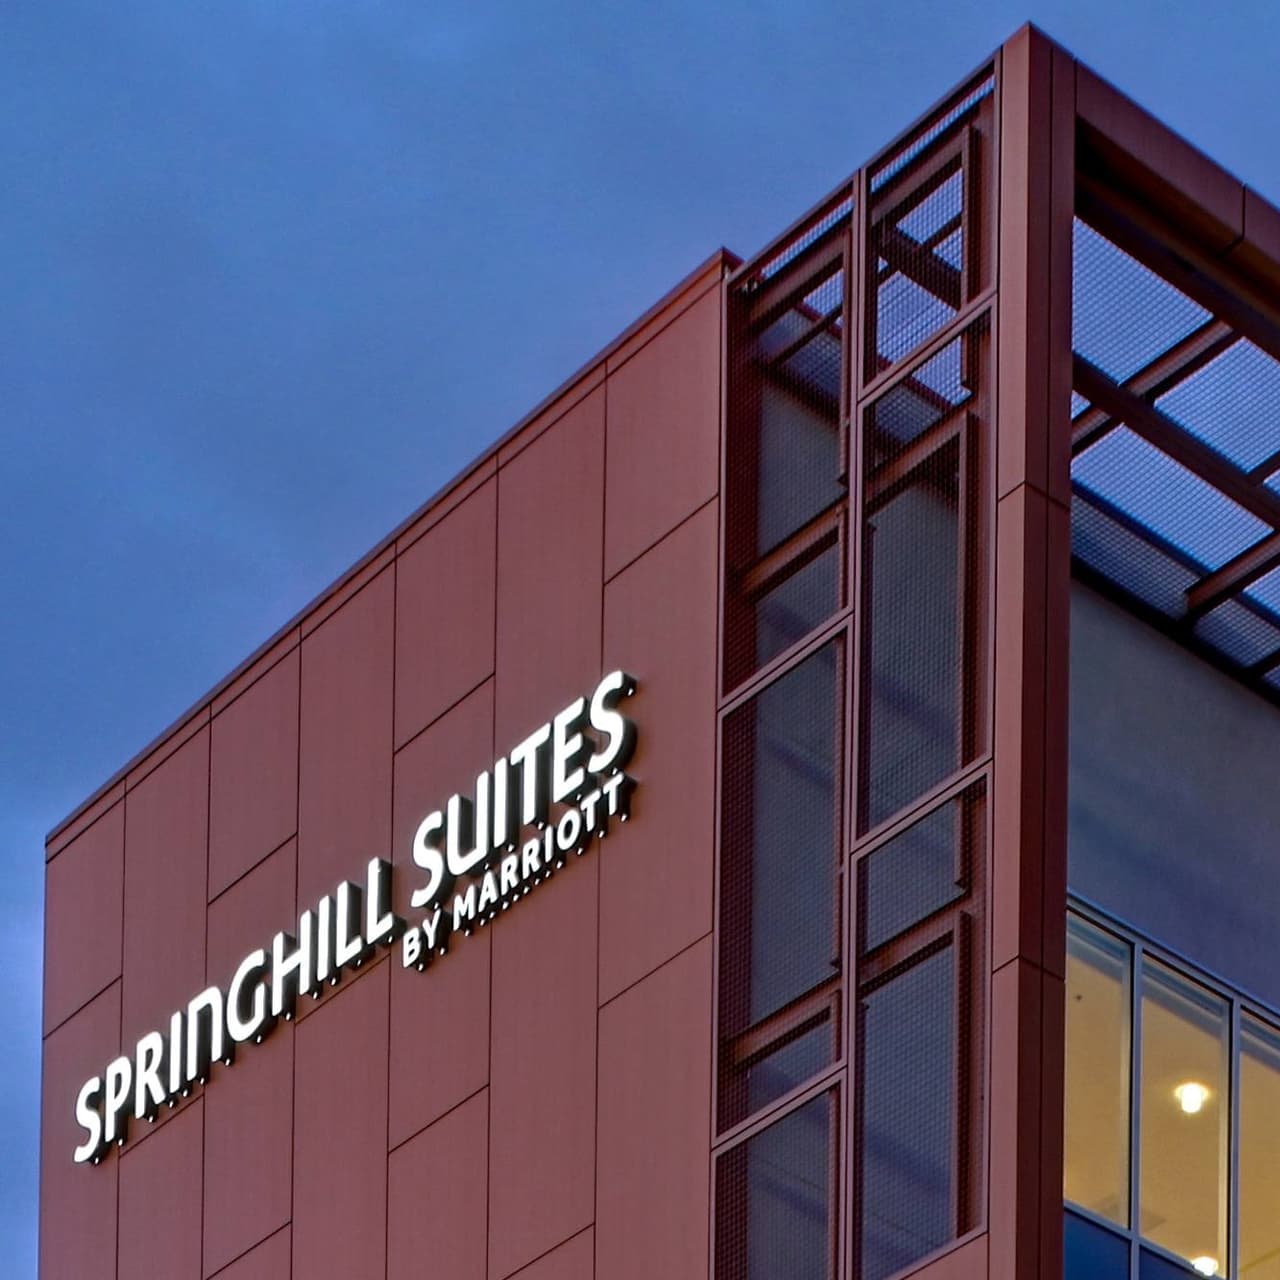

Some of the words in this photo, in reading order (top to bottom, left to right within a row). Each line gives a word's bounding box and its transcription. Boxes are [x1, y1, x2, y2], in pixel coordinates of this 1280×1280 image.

[74, 856, 394, 1163] SPRINGHILL
[411, 670, 625, 908] SUITES
[403, 909, 441, 968] BY
[453, 772, 624, 931] MARRIOTT
